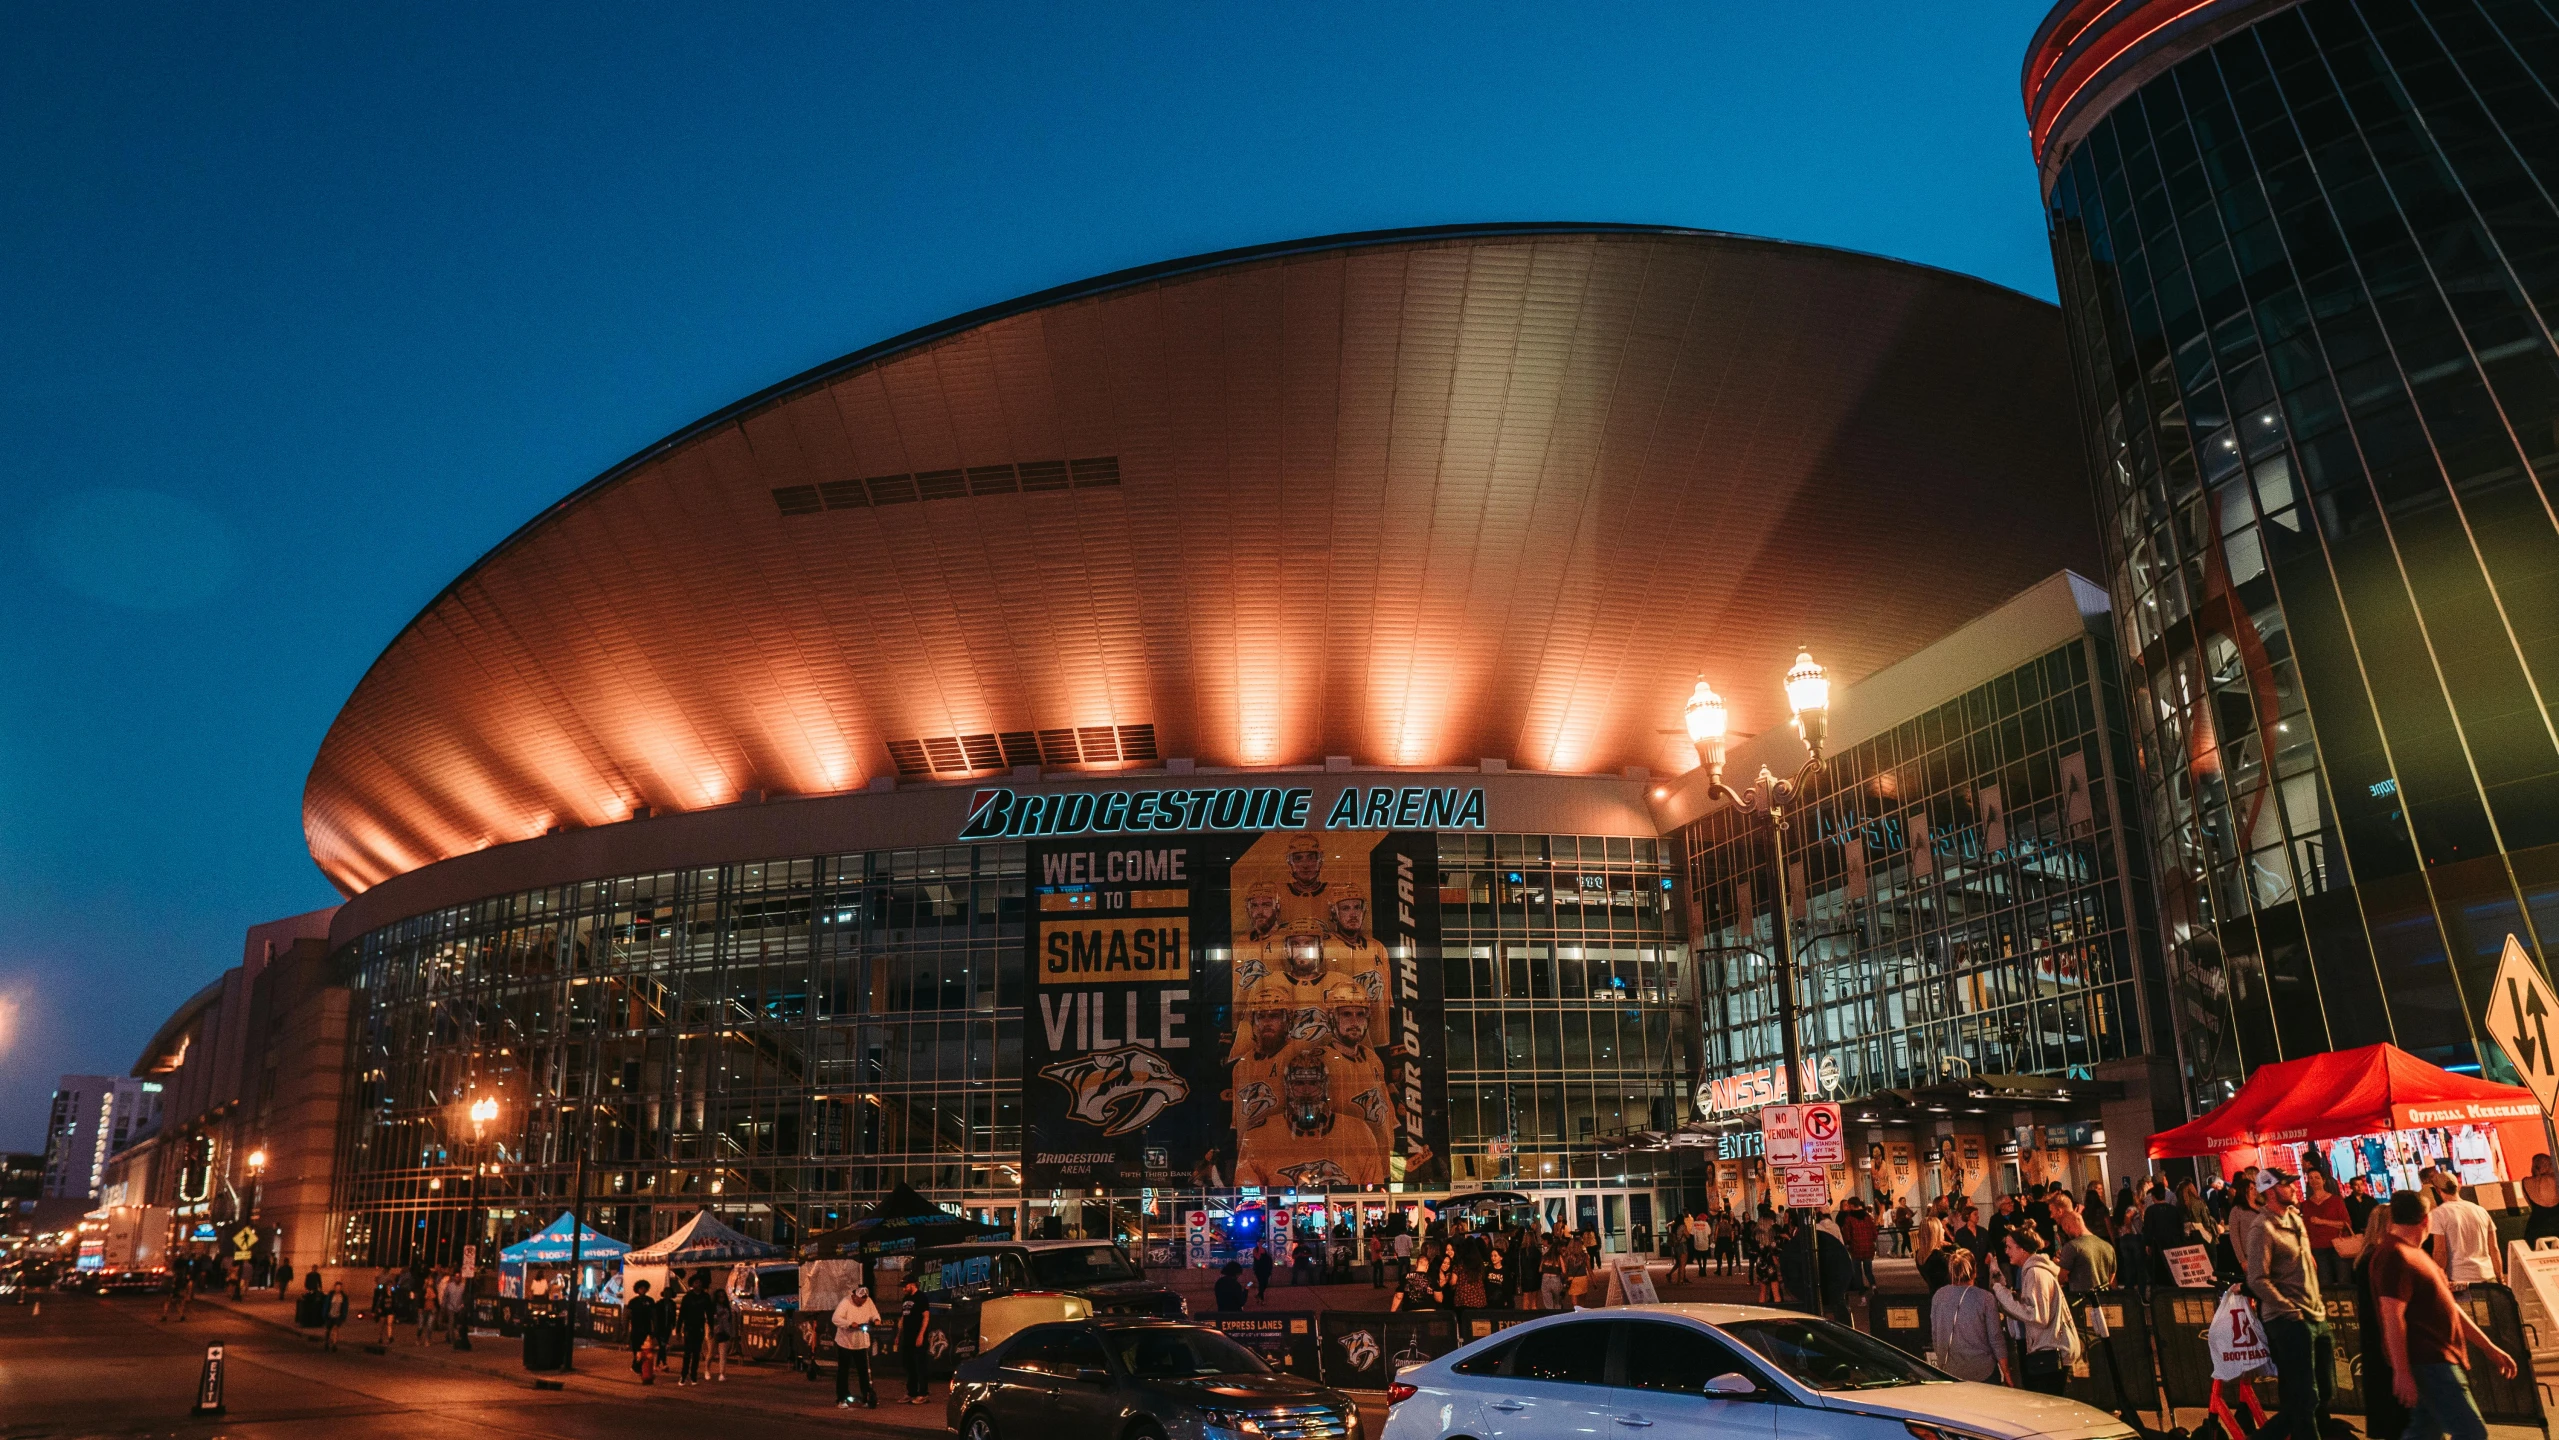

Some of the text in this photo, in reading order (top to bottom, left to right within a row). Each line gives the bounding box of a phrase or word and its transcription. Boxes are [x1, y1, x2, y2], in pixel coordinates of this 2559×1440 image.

[958, 787, 1487, 840] BRIDGESTONE ARENA
[1042, 849, 1187, 885] WELCOME
[1397, 852, 1415, 928] FAN
[1104, 891, 1123, 910] TO
[1048, 928, 1180, 973] SMASH
[1399, 932, 1419, 1001] THE
[1039, 990, 1190, 1051] VILLE
[1403, 1007, 1420, 1059] OF
[1711, 1058, 1818, 1112] NISSAN
[1404, 1062, 1424, 1155] YEAR
[2409, 1108, 2465, 1124] OFFICIAL
[1775, 1113, 1787, 1124] NO
[1767, 1128, 1799, 1140] VENDING
[2207, 1128, 2308, 1149] OFFICIAL MERCHANDISE
[1036, 1152, 1115, 1164] BRIDGESTONE
[1966, 1160, 1980, 1169] VILLE
[1060, 1165, 1091, 1174] ARENA
[1120, 1170, 1141, 1178] FIFTH
[1144, 1170, 1168, 1178] THIRD
[1831, 1171, 1846, 1180] VILLE
[1895, 1166, 1909, 1175] VILLE
[1722, 1181, 1738, 1189] VILLE
[880, 1237, 915, 1250] RIVER
[918, 1255, 991, 1292] THE RIVER
[1222, 1320, 1283, 1331] EXPRESS LANES
[2223, 1352, 2246, 1361] BOOT
[208, 1361, 218, 1402] EXIT
